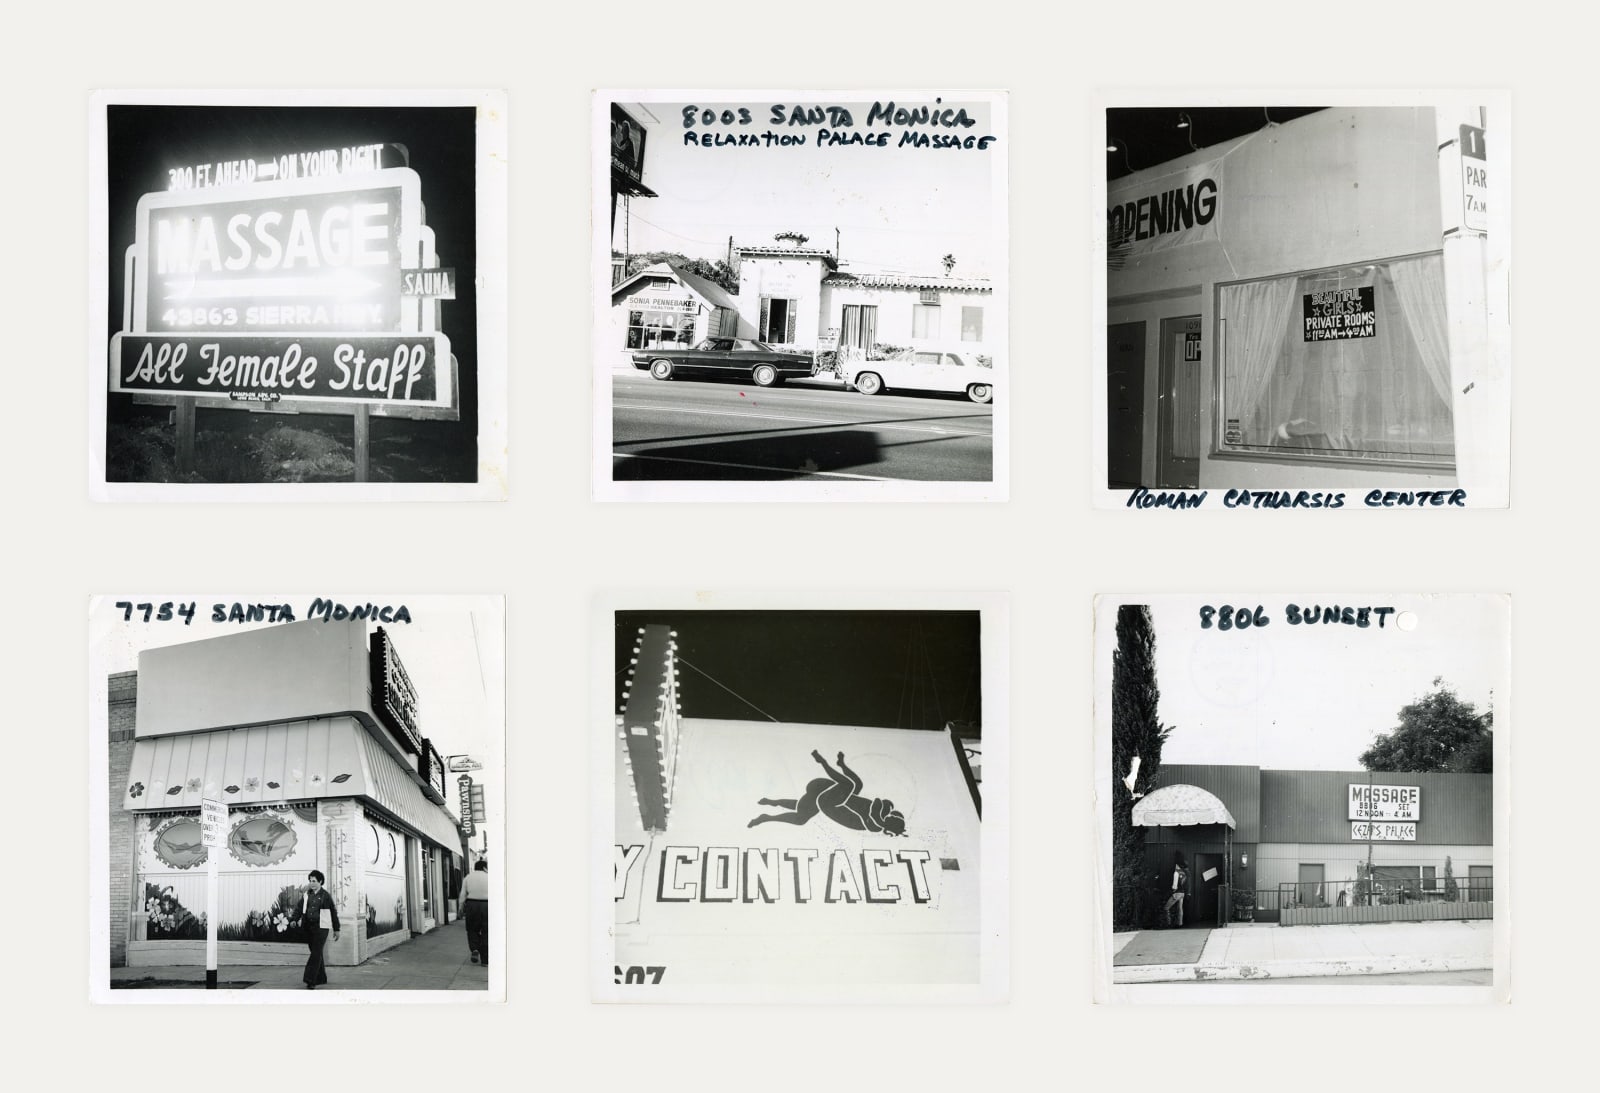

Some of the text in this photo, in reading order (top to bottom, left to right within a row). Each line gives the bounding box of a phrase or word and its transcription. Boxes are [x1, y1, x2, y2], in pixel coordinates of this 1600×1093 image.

[682, 105, 752, 128] 8003
[769, 104, 853, 128] SANTA
[684, 128, 996, 150] RELAXATION PALACE MASSAGE
[169, 167, 193, 191] 300
[215, 159, 257, 187] AHEAD
[279, 153, 298, 180] ON
[300, 149, 340, 178] YOUR
[341, 143, 384, 173] RIGHT
[157, 202, 390, 274] MASSAGE
[404, 272, 450, 296] SAUNA
[629, 297, 650, 305] SONIA
[652, 298, 697, 308] PENNEBAKER
[1322, 300, 1355, 316] GIRLS
[162, 307, 239, 326] 43863
[245, 304, 330, 325] SIERRA
[1305, 311, 1376, 331] PRIVATE ROOMS
[125, 342, 426, 400] All Female Staff
[1126, 486, 1467, 509] ROMAN CATHARSIS CENTER
[115, 597, 412, 625] 7754 SANTA MONICA
[1199, 604, 1270, 631] 8806
[1352, 787, 1417, 804] MASSAGE
[656, 845, 932, 904] CONTACT
